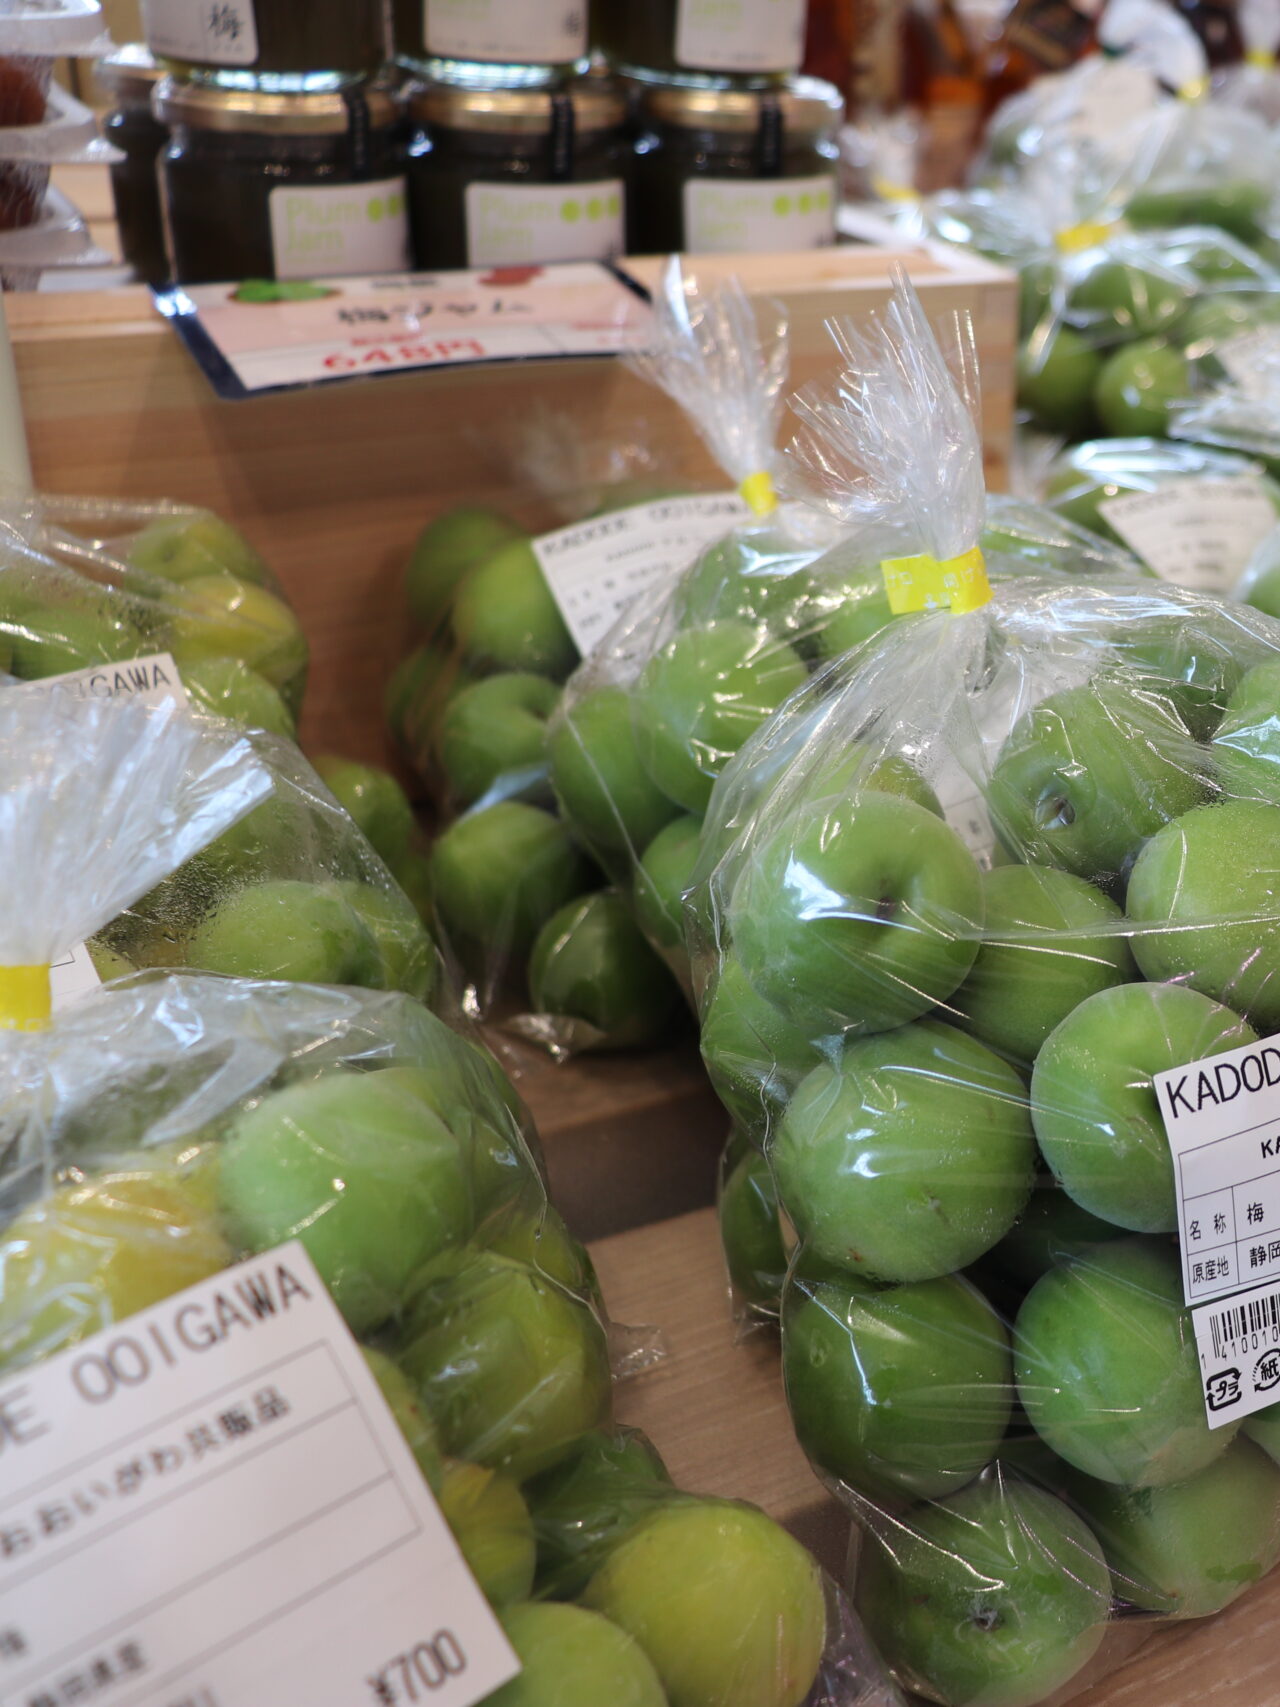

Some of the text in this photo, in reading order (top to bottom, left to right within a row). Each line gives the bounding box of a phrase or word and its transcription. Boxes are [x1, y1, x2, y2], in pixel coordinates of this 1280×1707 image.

[1246, 1203, 1265, 1225] 梅
[1191, 1256, 1230, 1285] 原産地
[70, 1263, 313, 1406] OOIGAWA
[366, 1628, 468, 1707] ¥700
